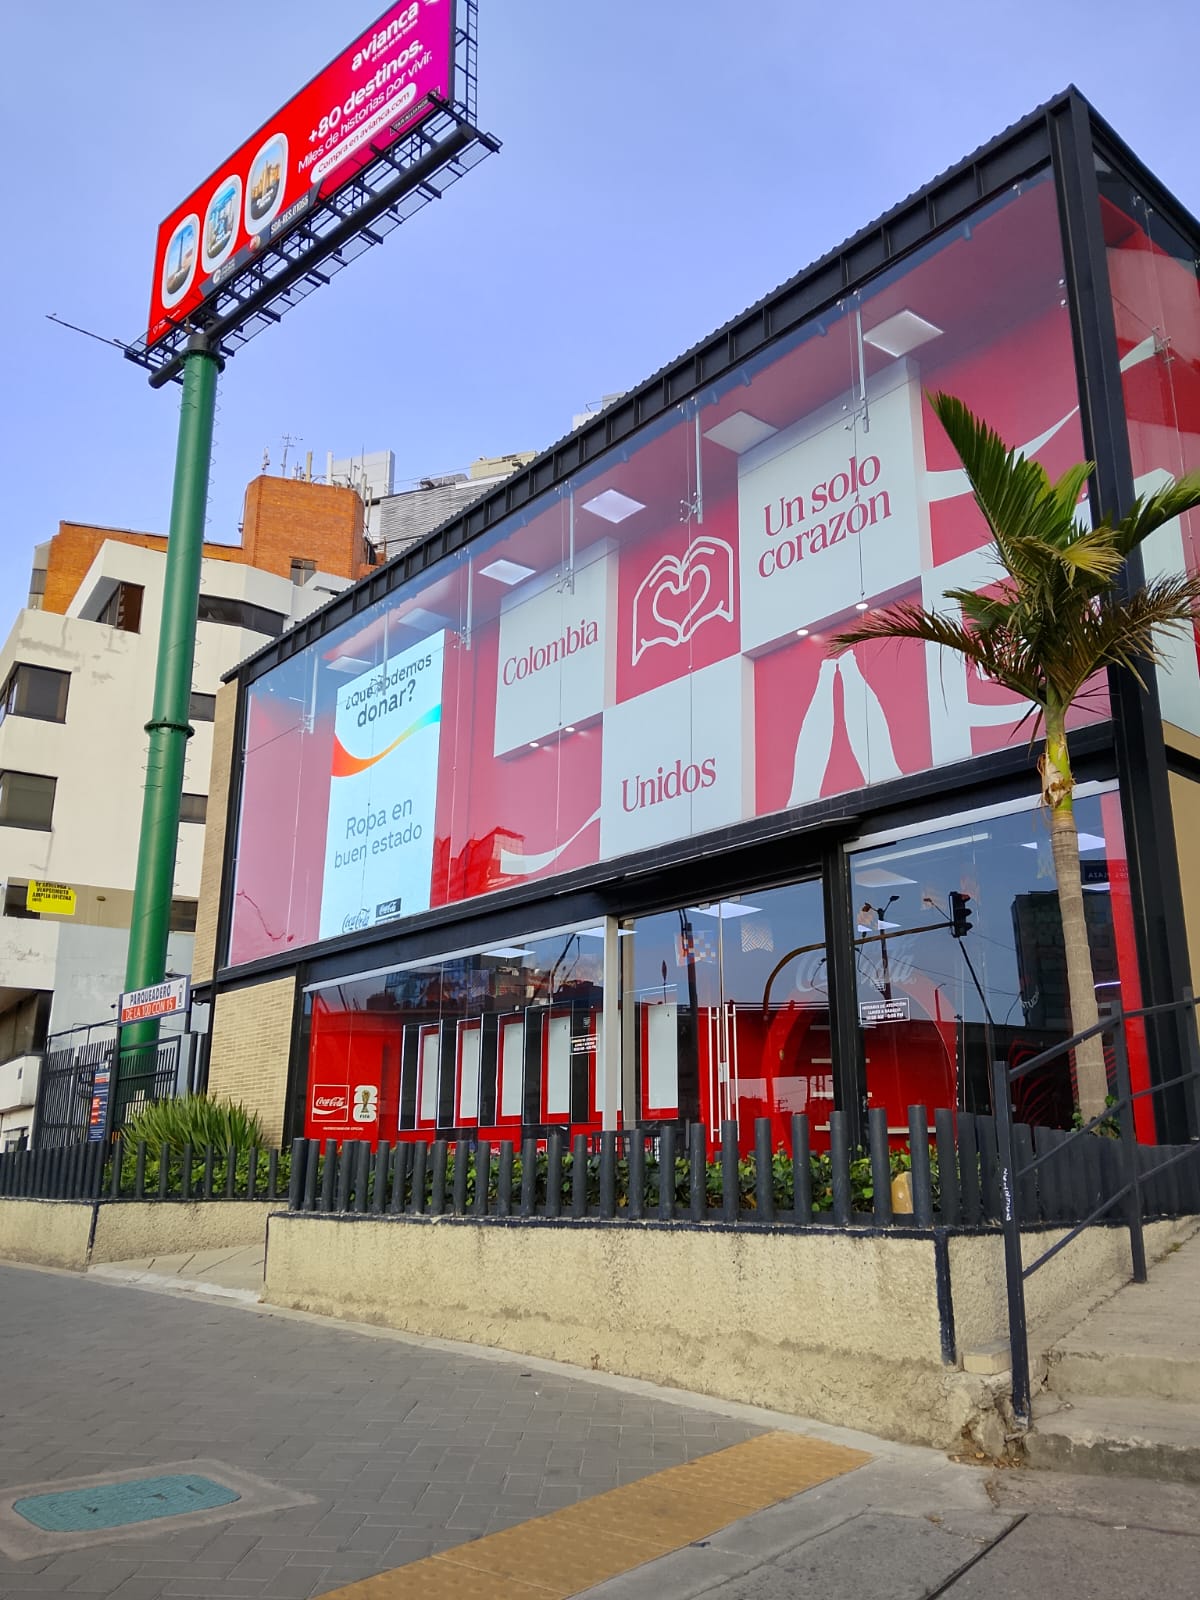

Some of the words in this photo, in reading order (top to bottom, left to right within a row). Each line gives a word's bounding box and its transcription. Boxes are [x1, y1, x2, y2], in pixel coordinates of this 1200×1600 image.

[351, 1, 419, 71] avianca
[298, 145, 324, 173] Miles
[325, 131, 339, 149] de
[340, 92, 385, 136] historias
[386, 71, 406, 101] por
[408, 50, 432, 77] vivir.
[309, 106, 341, 142] +80
[343, 40, 423, 115] destinos.
[318, 144, 348, 173] Compra
[349, 132, 360, 148] en
[360, 91, 410, 138] avianca.com
[764, 496, 805, 536] Un
[811, 455, 881, 514] solo
[758, 490, 892, 578] corazón
[502, 619, 599, 687] Colombia
[357, 679, 416, 728] donar?
[621, 757, 717, 812] Unidos
[334, 843, 367, 869] buen
[372, 822, 423, 855] estado
[346, 808, 387, 840] Ropa
[392, 799, 413, 822] en
[125, 1009, 133, 1020] DE
[133, 1007, 141, 1018] LA
[142, 1004, 152, 1016] 100
[152, 1001, 165, 1014] CON
[166, 998, 173, 1010] 15
[130, 984, 171, 1005] PARQUEADERO
[315, 1096, 345, 1107] Coca-Cola
